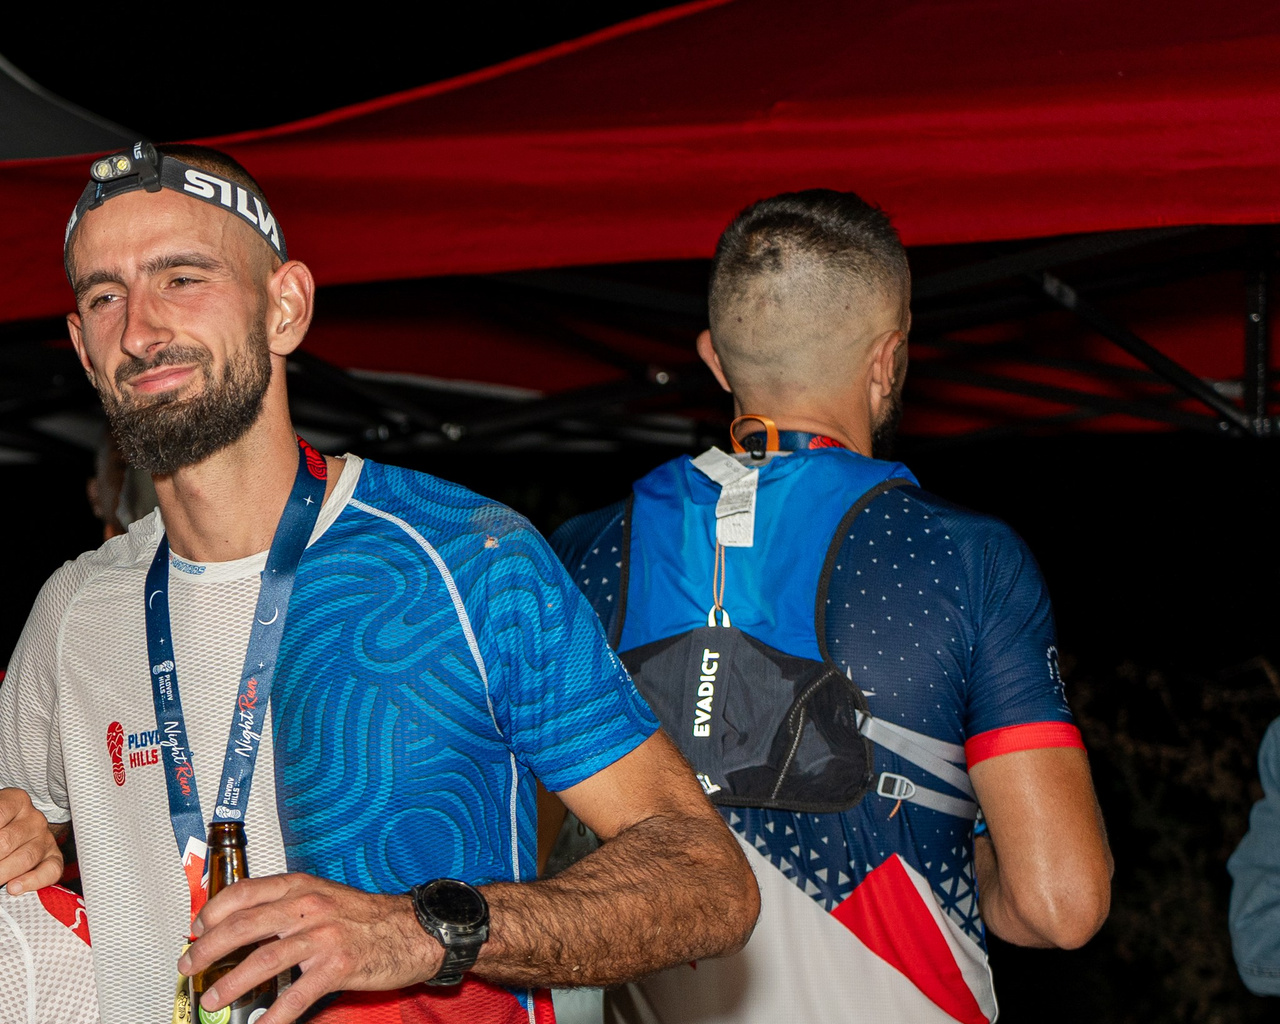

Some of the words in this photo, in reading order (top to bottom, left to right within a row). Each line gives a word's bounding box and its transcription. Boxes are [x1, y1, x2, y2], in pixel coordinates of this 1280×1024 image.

[238, 677, 259, 712] Run
[693, 648, 720, 737] EVADICT
[234, 710, 261, 758] Night
[128, 748, 159, 769] HILLS
[160, 721, 187, 764] Night
[174, 762, 193, 797] Run
[223, 777, 235, 805] PLOVDIV
[230, 787, 240, 806] HILLS
